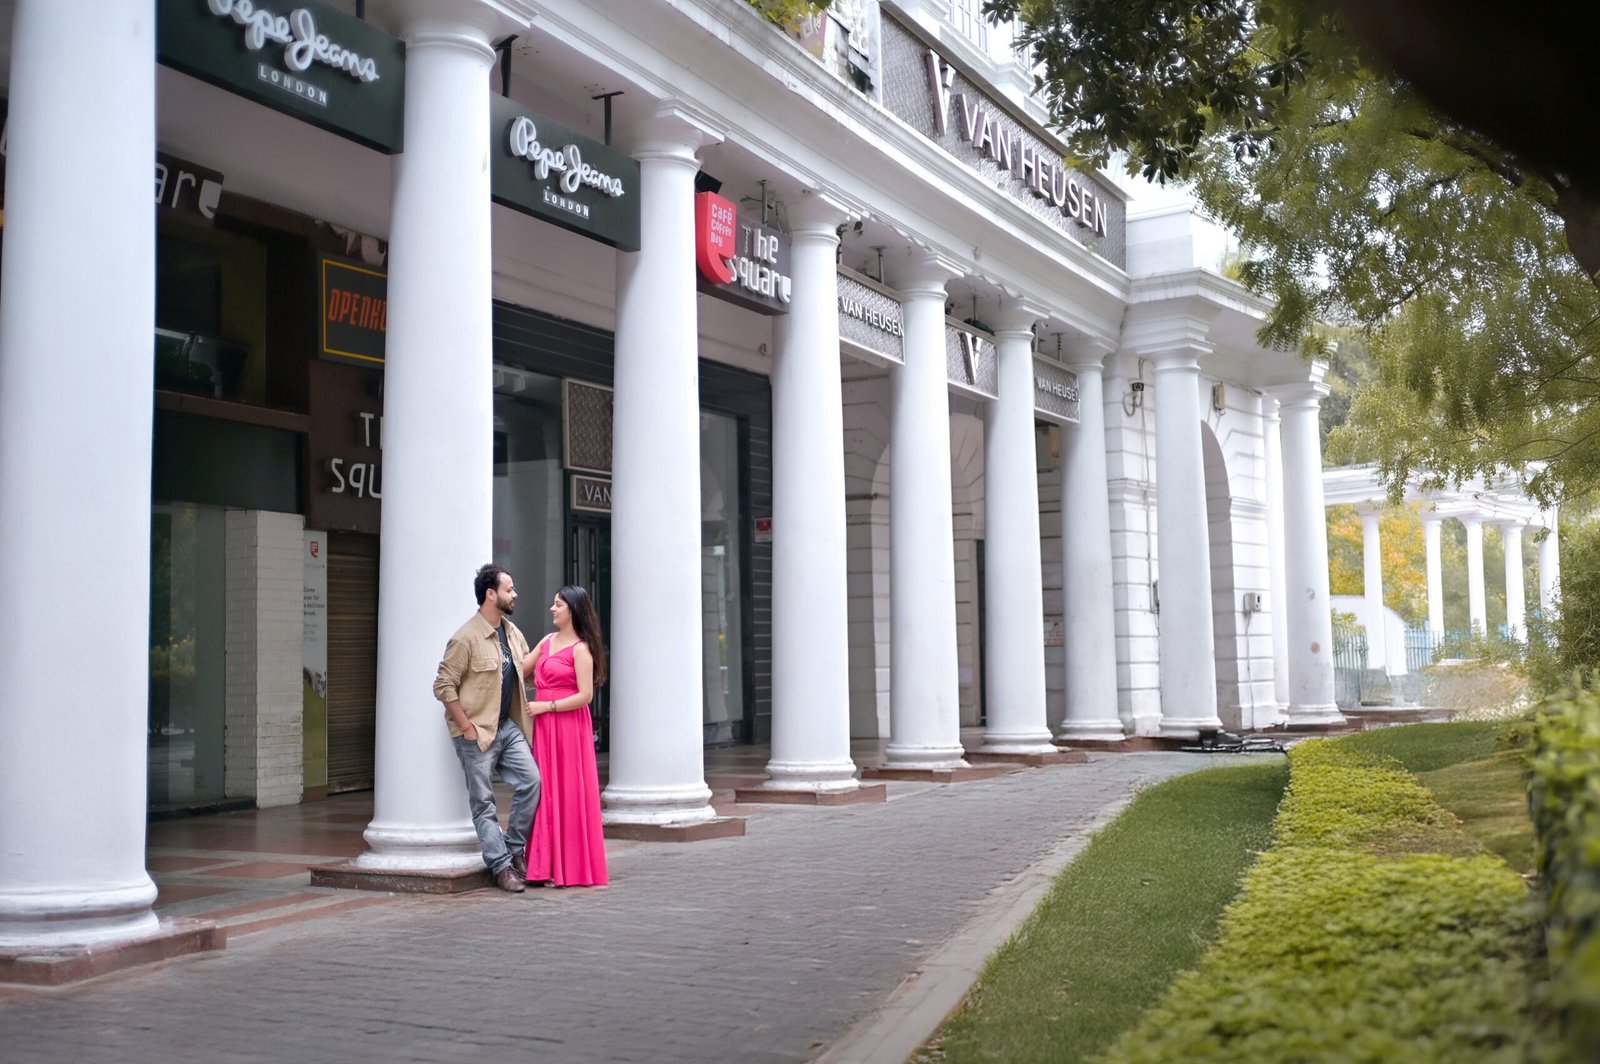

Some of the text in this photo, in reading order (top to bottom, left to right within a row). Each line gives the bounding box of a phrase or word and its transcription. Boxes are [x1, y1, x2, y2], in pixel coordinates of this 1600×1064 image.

[284, 8, 380, 82] Jeans
[259, 65, 327, 104] LONDON
[510, 116, 625, 197] Pepe Jeans
[957, 93, 1107, 237] VAN HEUSEN
[544, 193, 589, 217] LONDON
[711, 231, 723, 247] Day
[742, 224, 779, 264] The
[841, 295, 904, 337] VAN HEUSEN
[960, 332, 982, 385] V
[1037, 376, 1051, 392] VAN
[584, 485, 611, 503] VAN
